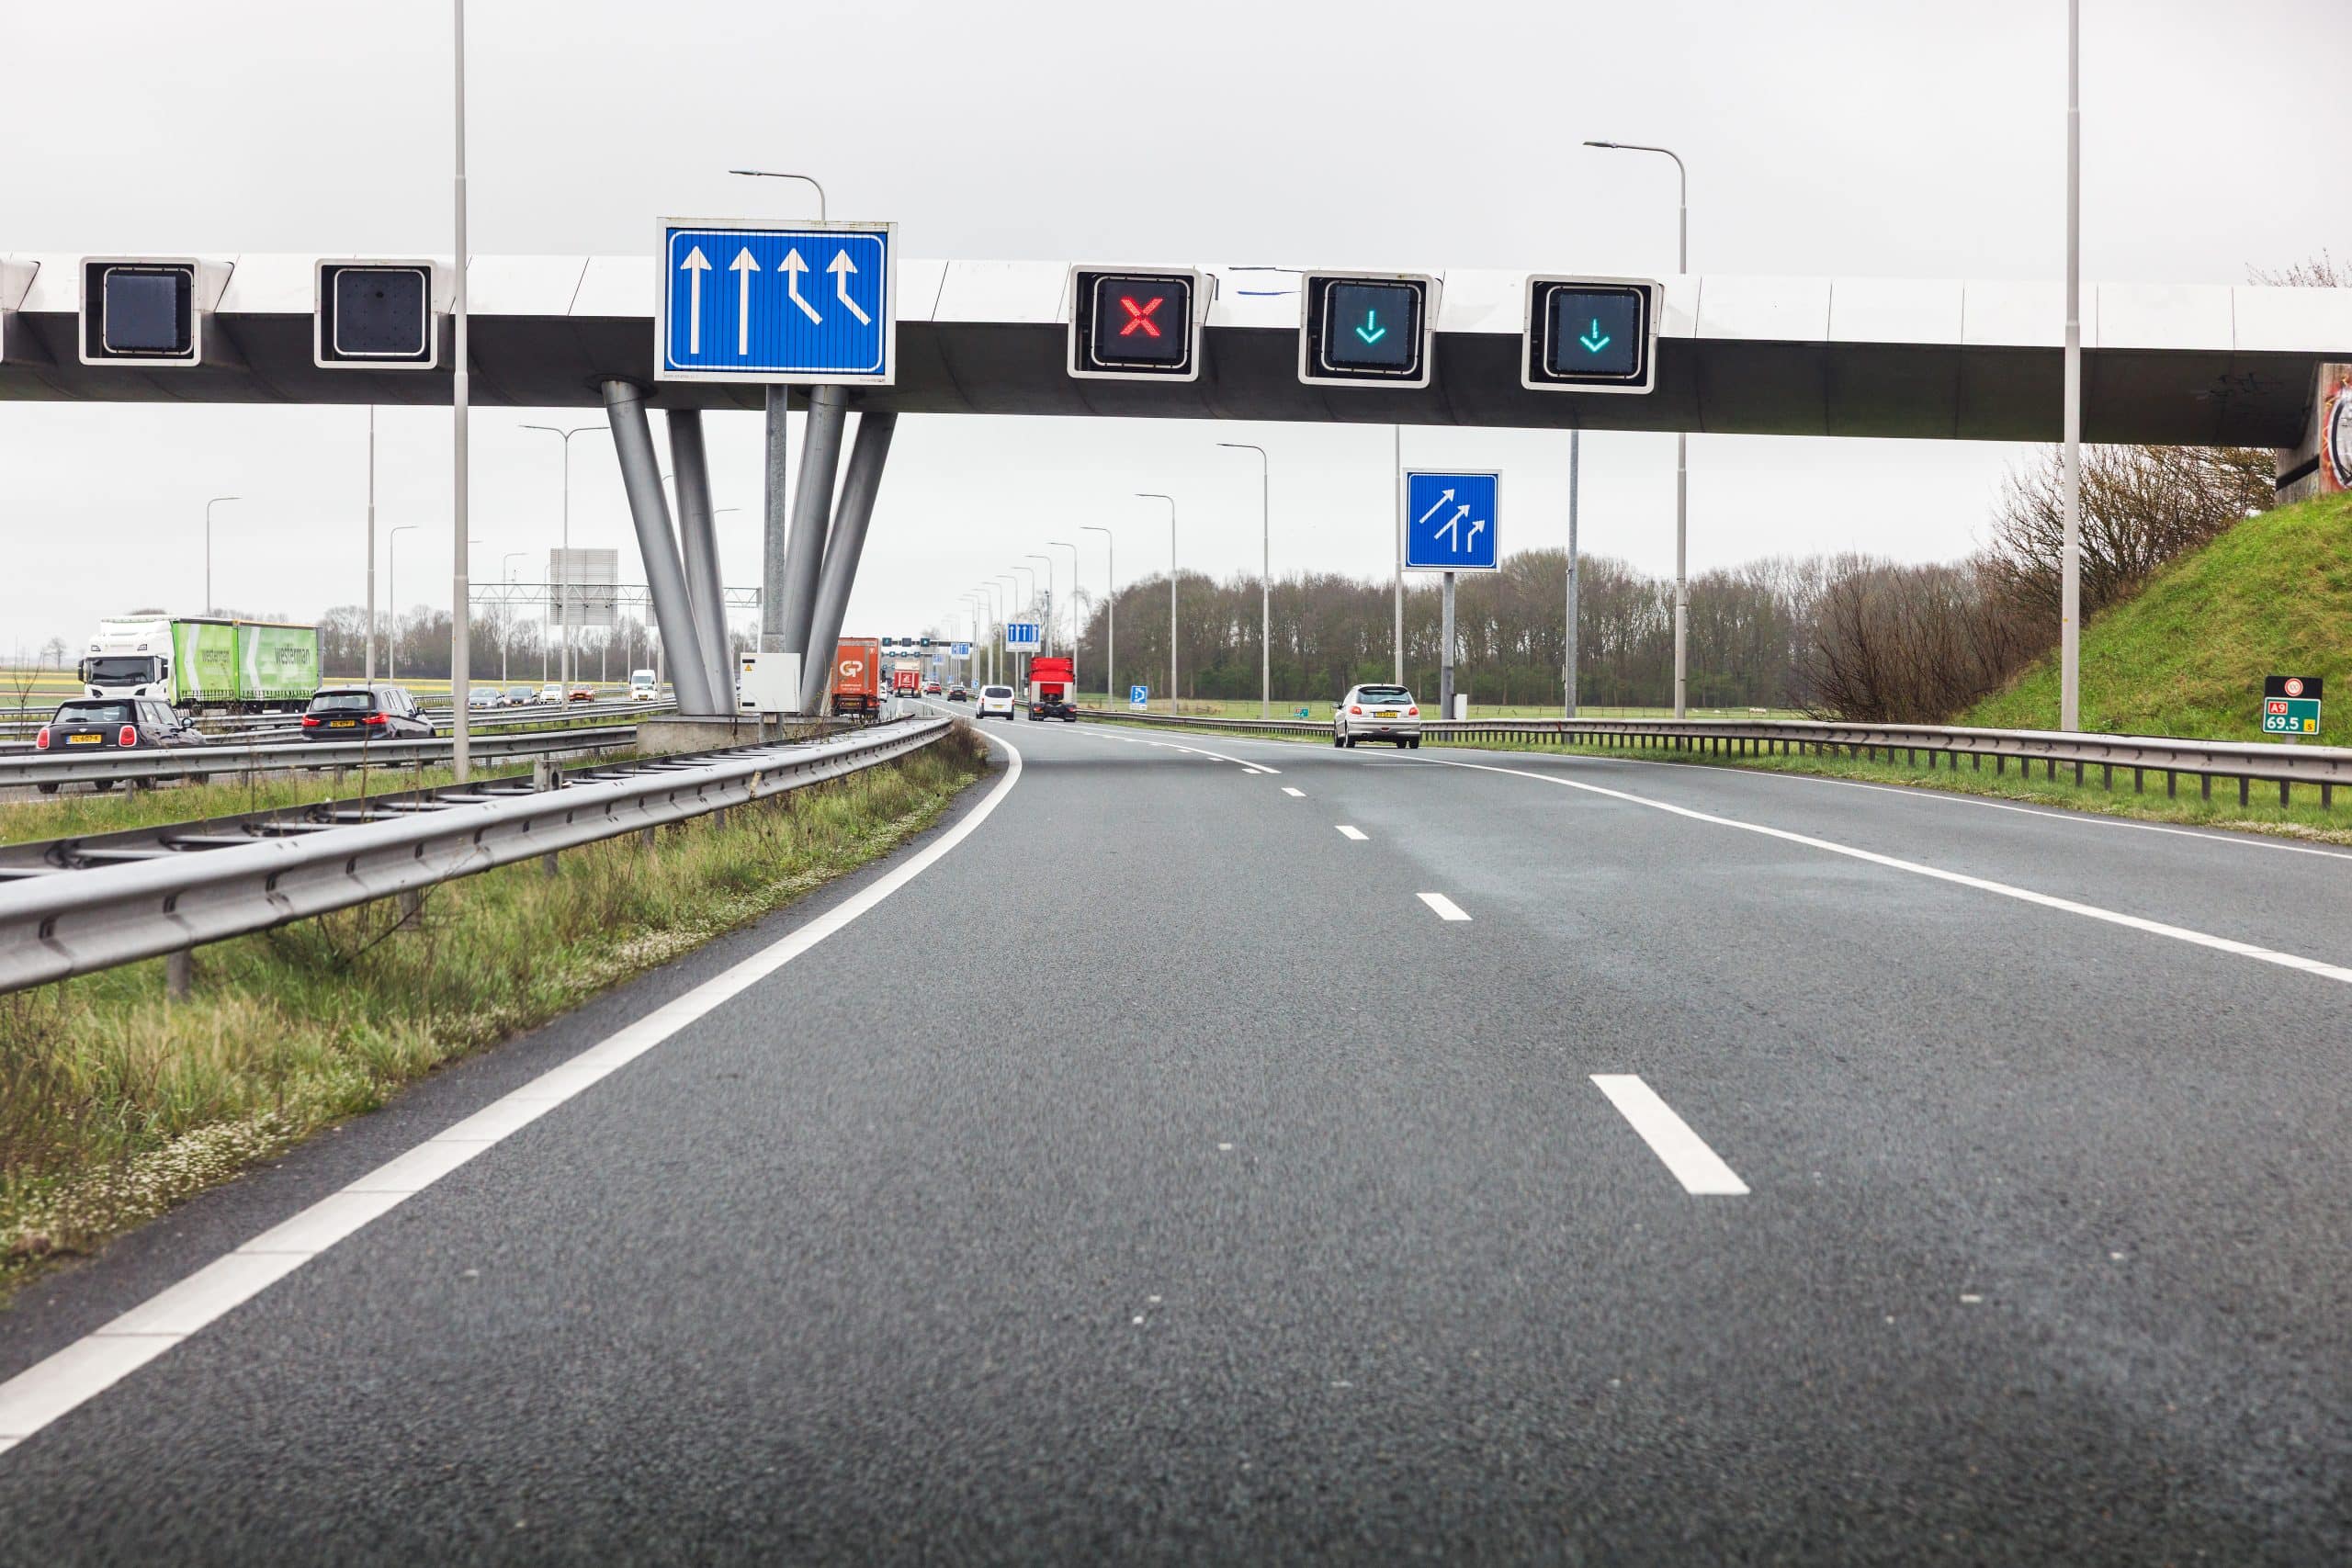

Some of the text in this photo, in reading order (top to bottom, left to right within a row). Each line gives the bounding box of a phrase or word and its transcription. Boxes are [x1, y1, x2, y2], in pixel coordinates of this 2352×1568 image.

[202, 649, 230, 662] westerman
[275, 646, 310, 664] westerman
[2270, 703, 2285, 713] A9
[2267, 716, 2299, 730] 69.5
